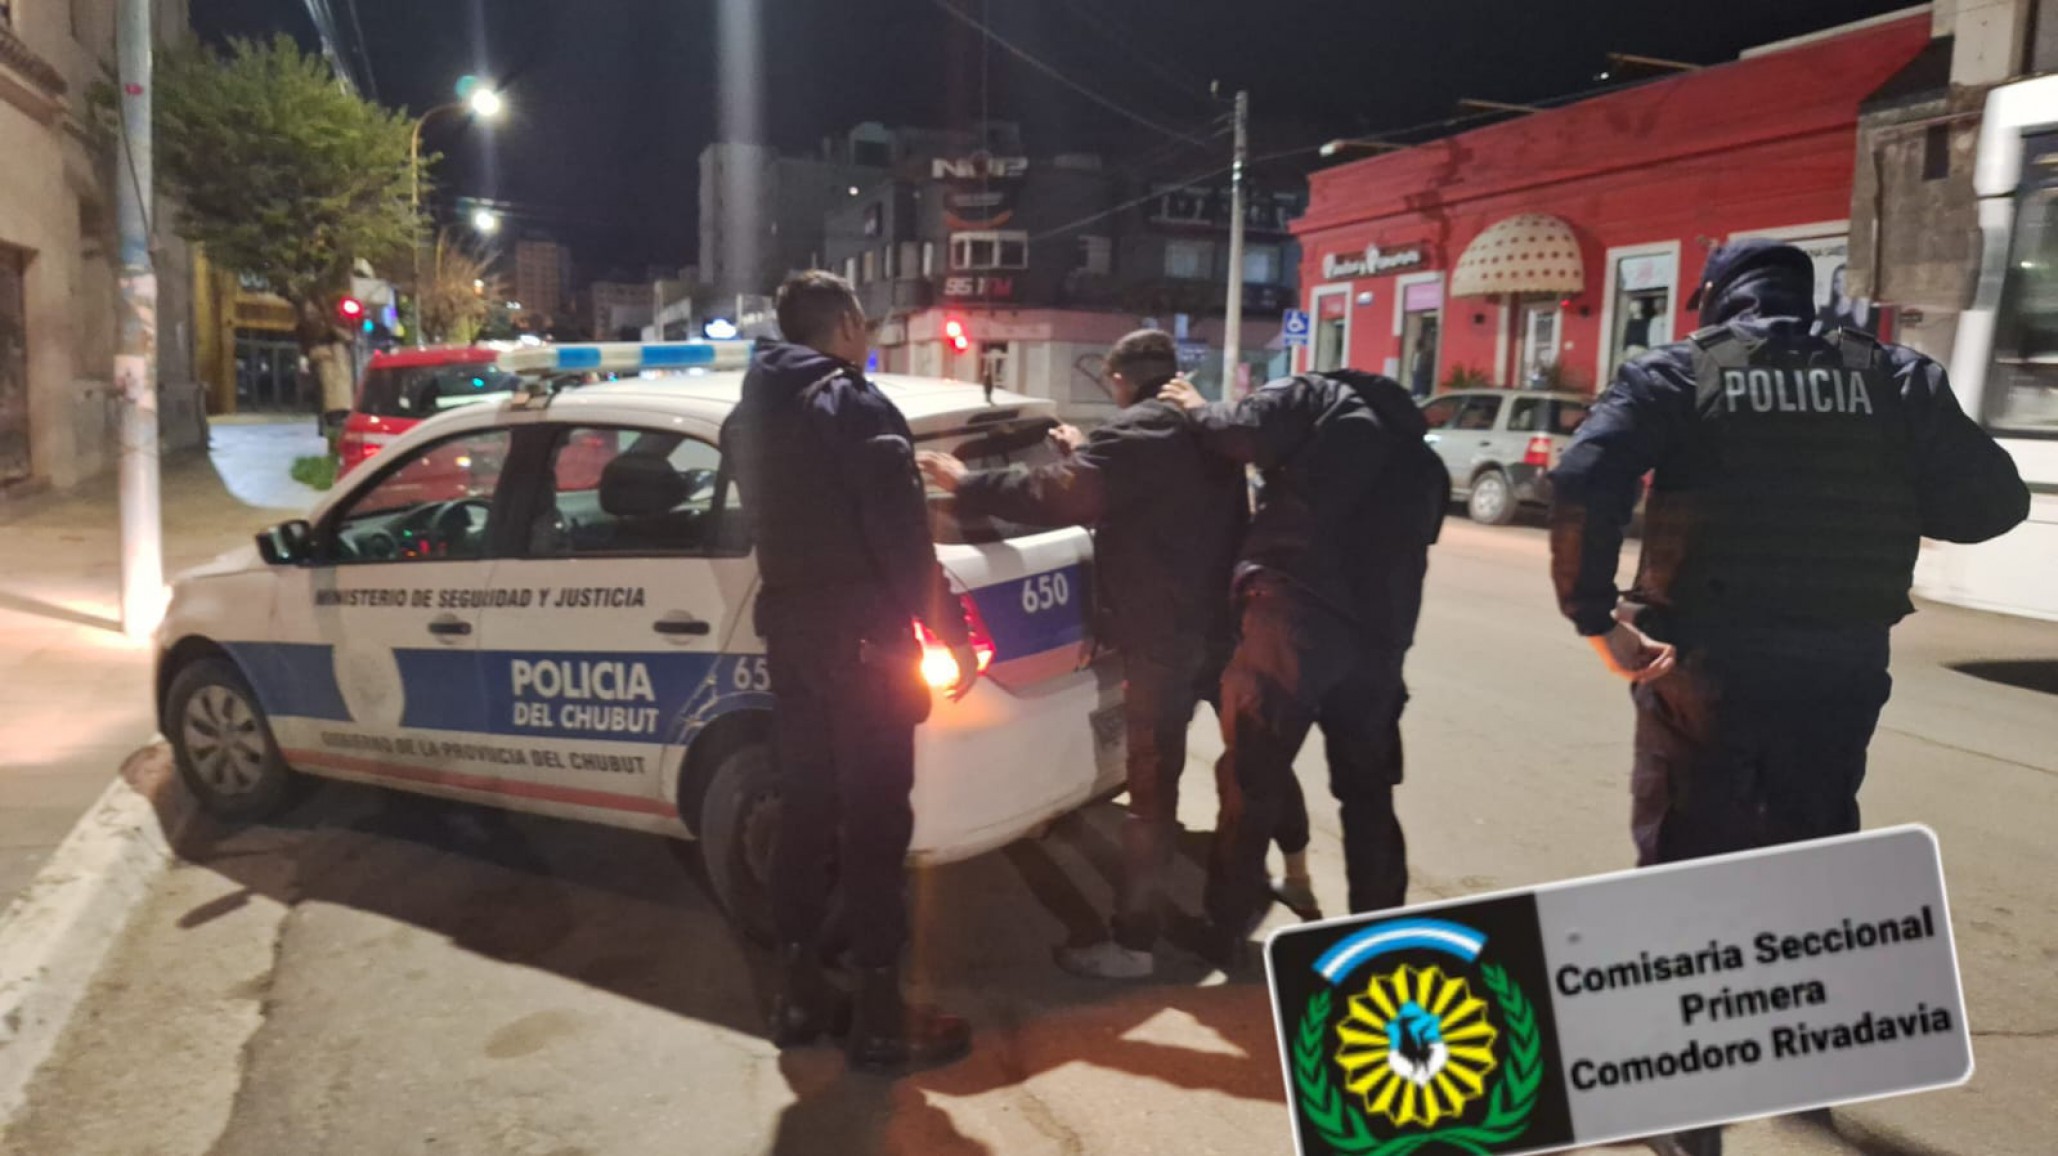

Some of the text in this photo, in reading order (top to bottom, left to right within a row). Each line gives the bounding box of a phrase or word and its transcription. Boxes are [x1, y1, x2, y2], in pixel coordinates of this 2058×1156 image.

[1724, 368, 1873, 415] POLICIA
[411, 589, 433, 608] DE
[539, 588, 551, 608] Y
[554, 586, 646, 608] JUSTICIA
[1022, 572, 1069, 613] 650
[511, 659, 655, 701] POLICIA
[733, 656, 771, 691] 65
[513, 702, 660, 733] DEL CHUBUT
[529, 749, 566, 769] DEL
[568, 752, 645, 775] CHUBUT
